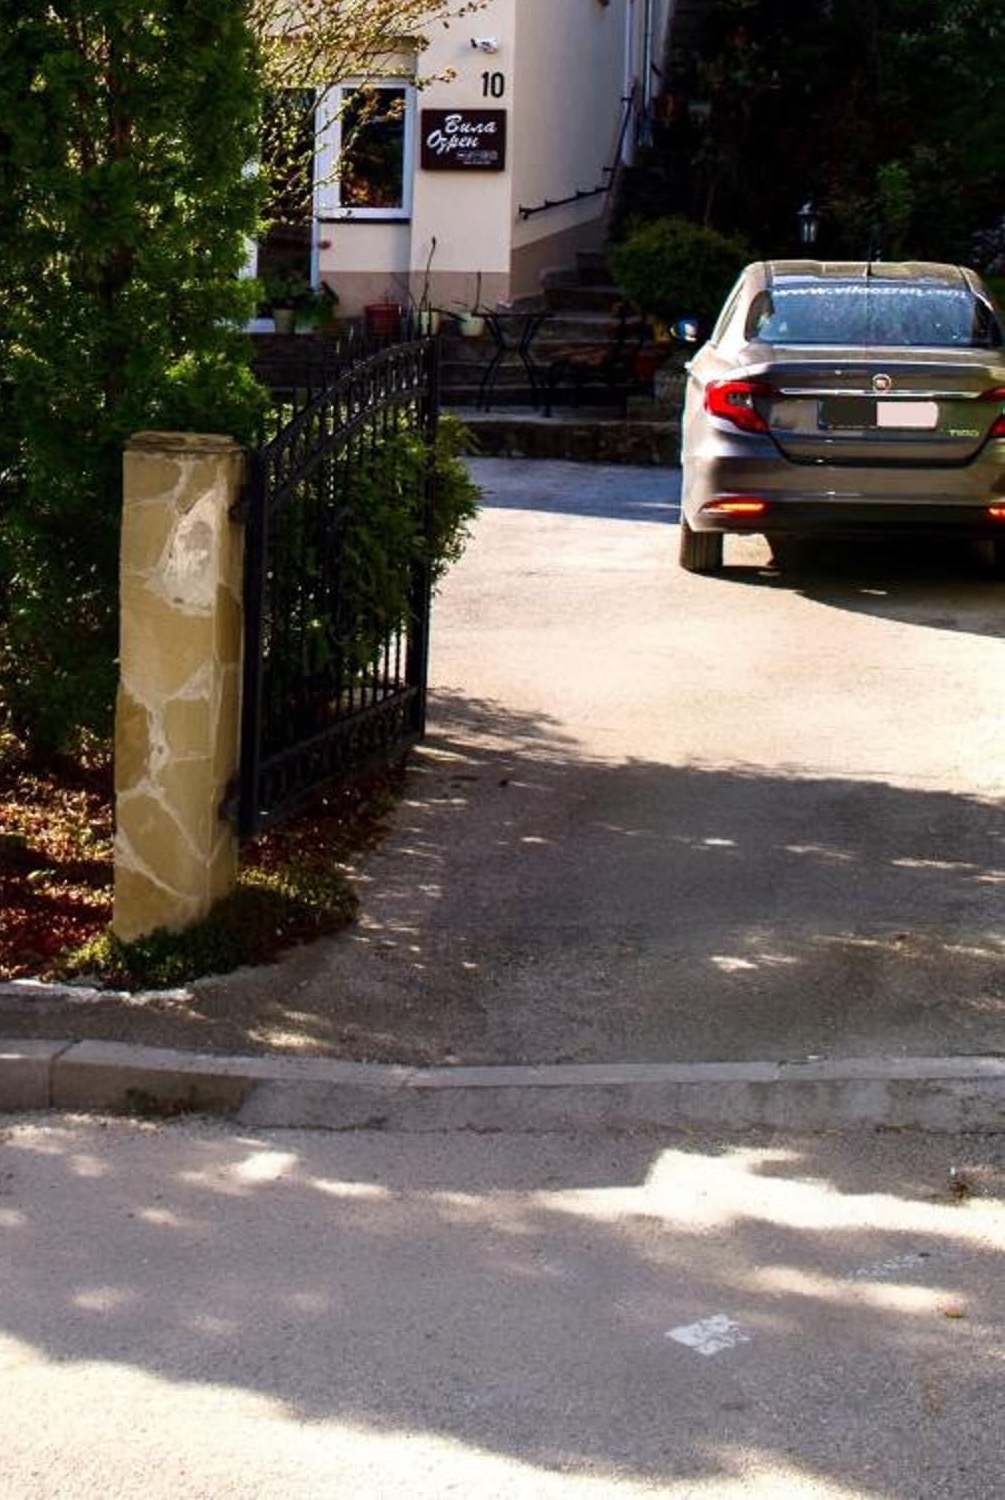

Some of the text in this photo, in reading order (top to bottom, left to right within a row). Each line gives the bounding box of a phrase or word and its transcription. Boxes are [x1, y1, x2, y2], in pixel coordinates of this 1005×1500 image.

[482, 71, 505, 98] 10
[444, 114, 497, 133] Вила
[426, 129, 479, 155] Озрен
